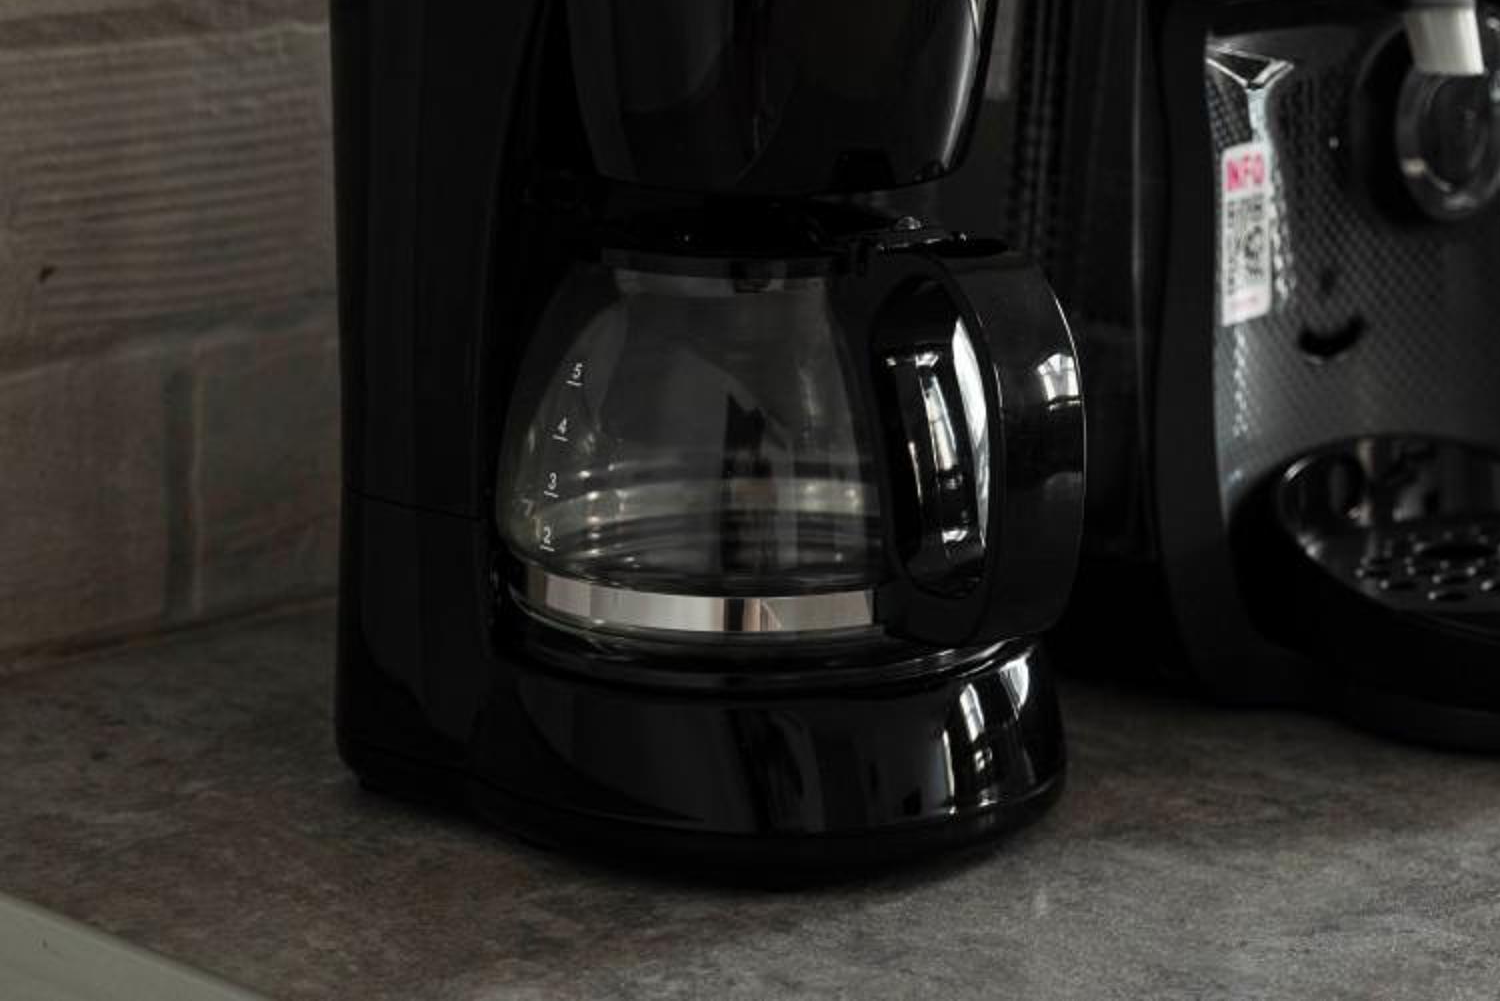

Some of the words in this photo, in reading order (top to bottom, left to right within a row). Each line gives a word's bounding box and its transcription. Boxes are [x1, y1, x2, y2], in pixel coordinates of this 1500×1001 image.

[572, 362, 583, 379] 5
[557, 417, 567, 435] 4
[547, 472, 557, 490] 3
